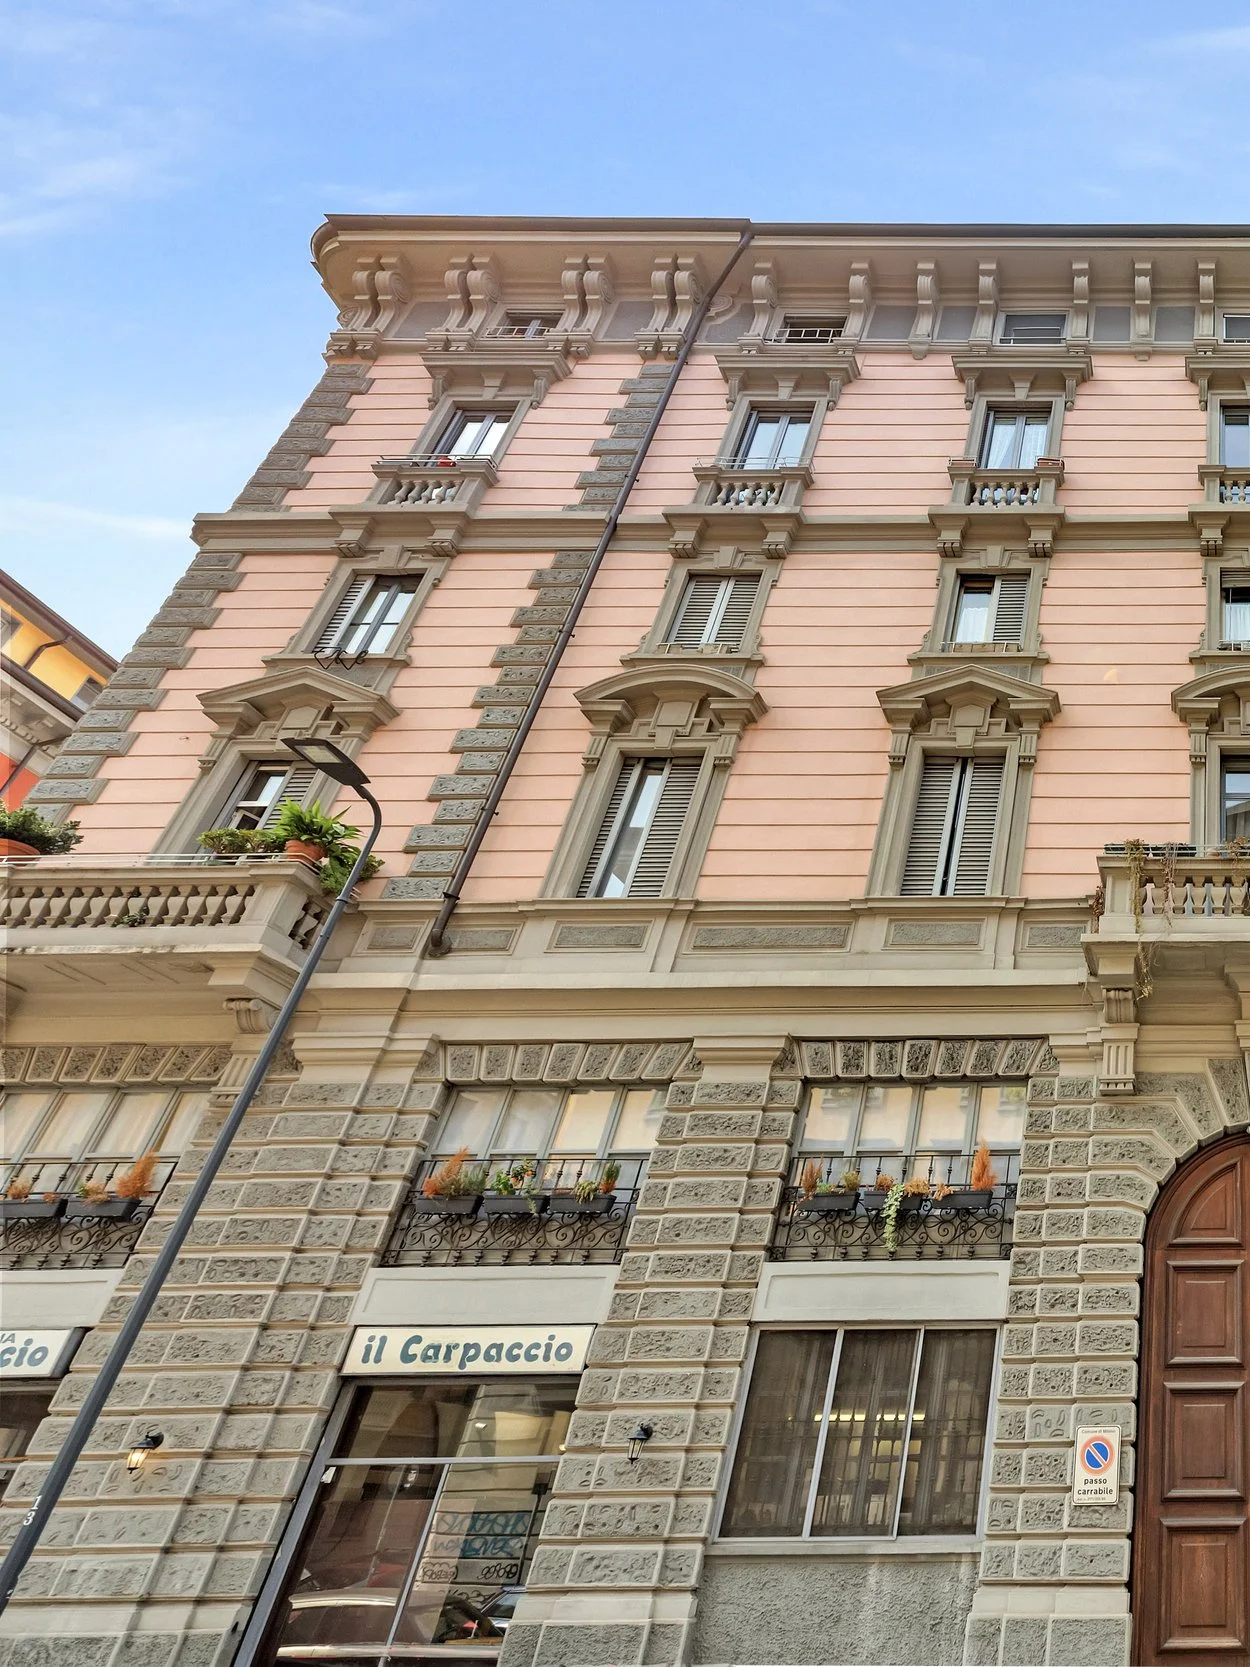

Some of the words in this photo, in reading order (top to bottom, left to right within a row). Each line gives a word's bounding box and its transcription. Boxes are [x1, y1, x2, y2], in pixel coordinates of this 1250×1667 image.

[361, 1334, 388, 1364] il
[399, 1334, 574, 1371] Carpaccio
[1083, 1478, 1108, 1486] passo
[1077, 1487, 1114, 1495] carrabile
